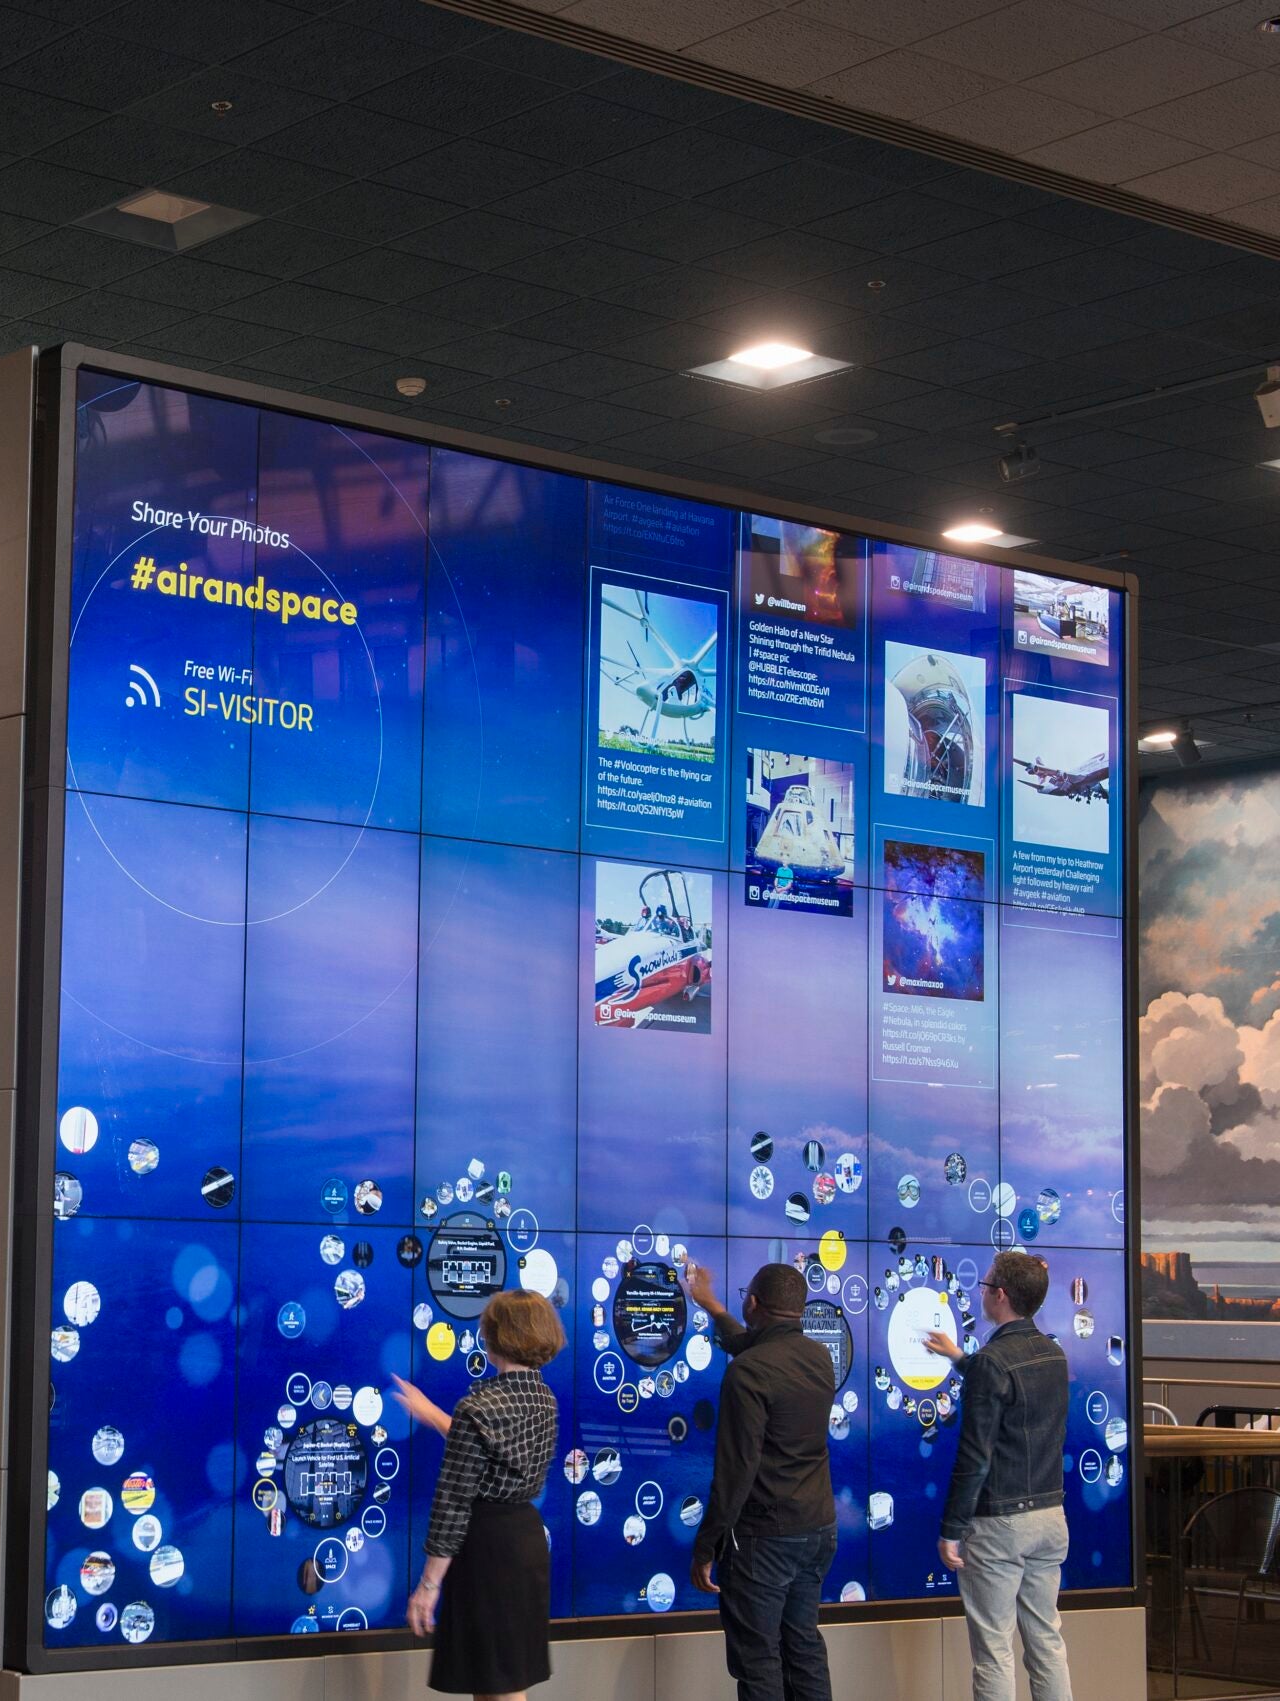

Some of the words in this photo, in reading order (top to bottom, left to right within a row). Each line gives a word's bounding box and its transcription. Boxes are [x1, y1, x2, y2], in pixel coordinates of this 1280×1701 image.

[131, 501, 183, 529] Share
[187, 511, 227, 537] Your
[231, 519, 290, 549] Photos
[131, 556, 358, 625] #airandspace
[749, 621, 774, 634] Golden
[774, 626, 790, 637] Halo
[790, 629, 798, 638] of
[799, 632, 804, 640] a
[804, 632, 820, 643] New
[820, 634, 835, 645] Star
[749, 634, 775, 649] Shining
[775, 640, 801, 653] through
[802, 644, 814, 655] the
[814, 646, 831, 658] Trifid
[832, 649, 856, 662] Nebula
[753, 648, 779, 661] #space
[780, 653, 790, 664] pic
[1029, 635, 1097, 655] @airandspacemuseum
[184, 660, 214, 680] Free
[218, 665, 253, 686] Wi-Fi
[184, 687, 314, 732] SI-VISITOR
[597, 771, 607, 781] of
[607, 773, 620, 783] the
[620, 774, 644, 787] future.
[598, 757, 612, 768] The
[614, 759, 660, 775] #Volocopter
[660, 766, 667, 776] is
[667, 768, 680, 778] the
[680, 769, 700, 782] flying
[700, 774, 713, 782] car
[678, 795, 713, 809] #aviation
[1012, 863, 1034, 874] Airport
[1018, 850, 1030, 861] few
[1031, 852, 1046, 863] from
[1046, 855, 1056, 866] my
[1075, 859, 1104, 871] Heathrow
[1061, 882, 1079, 894] heavy
